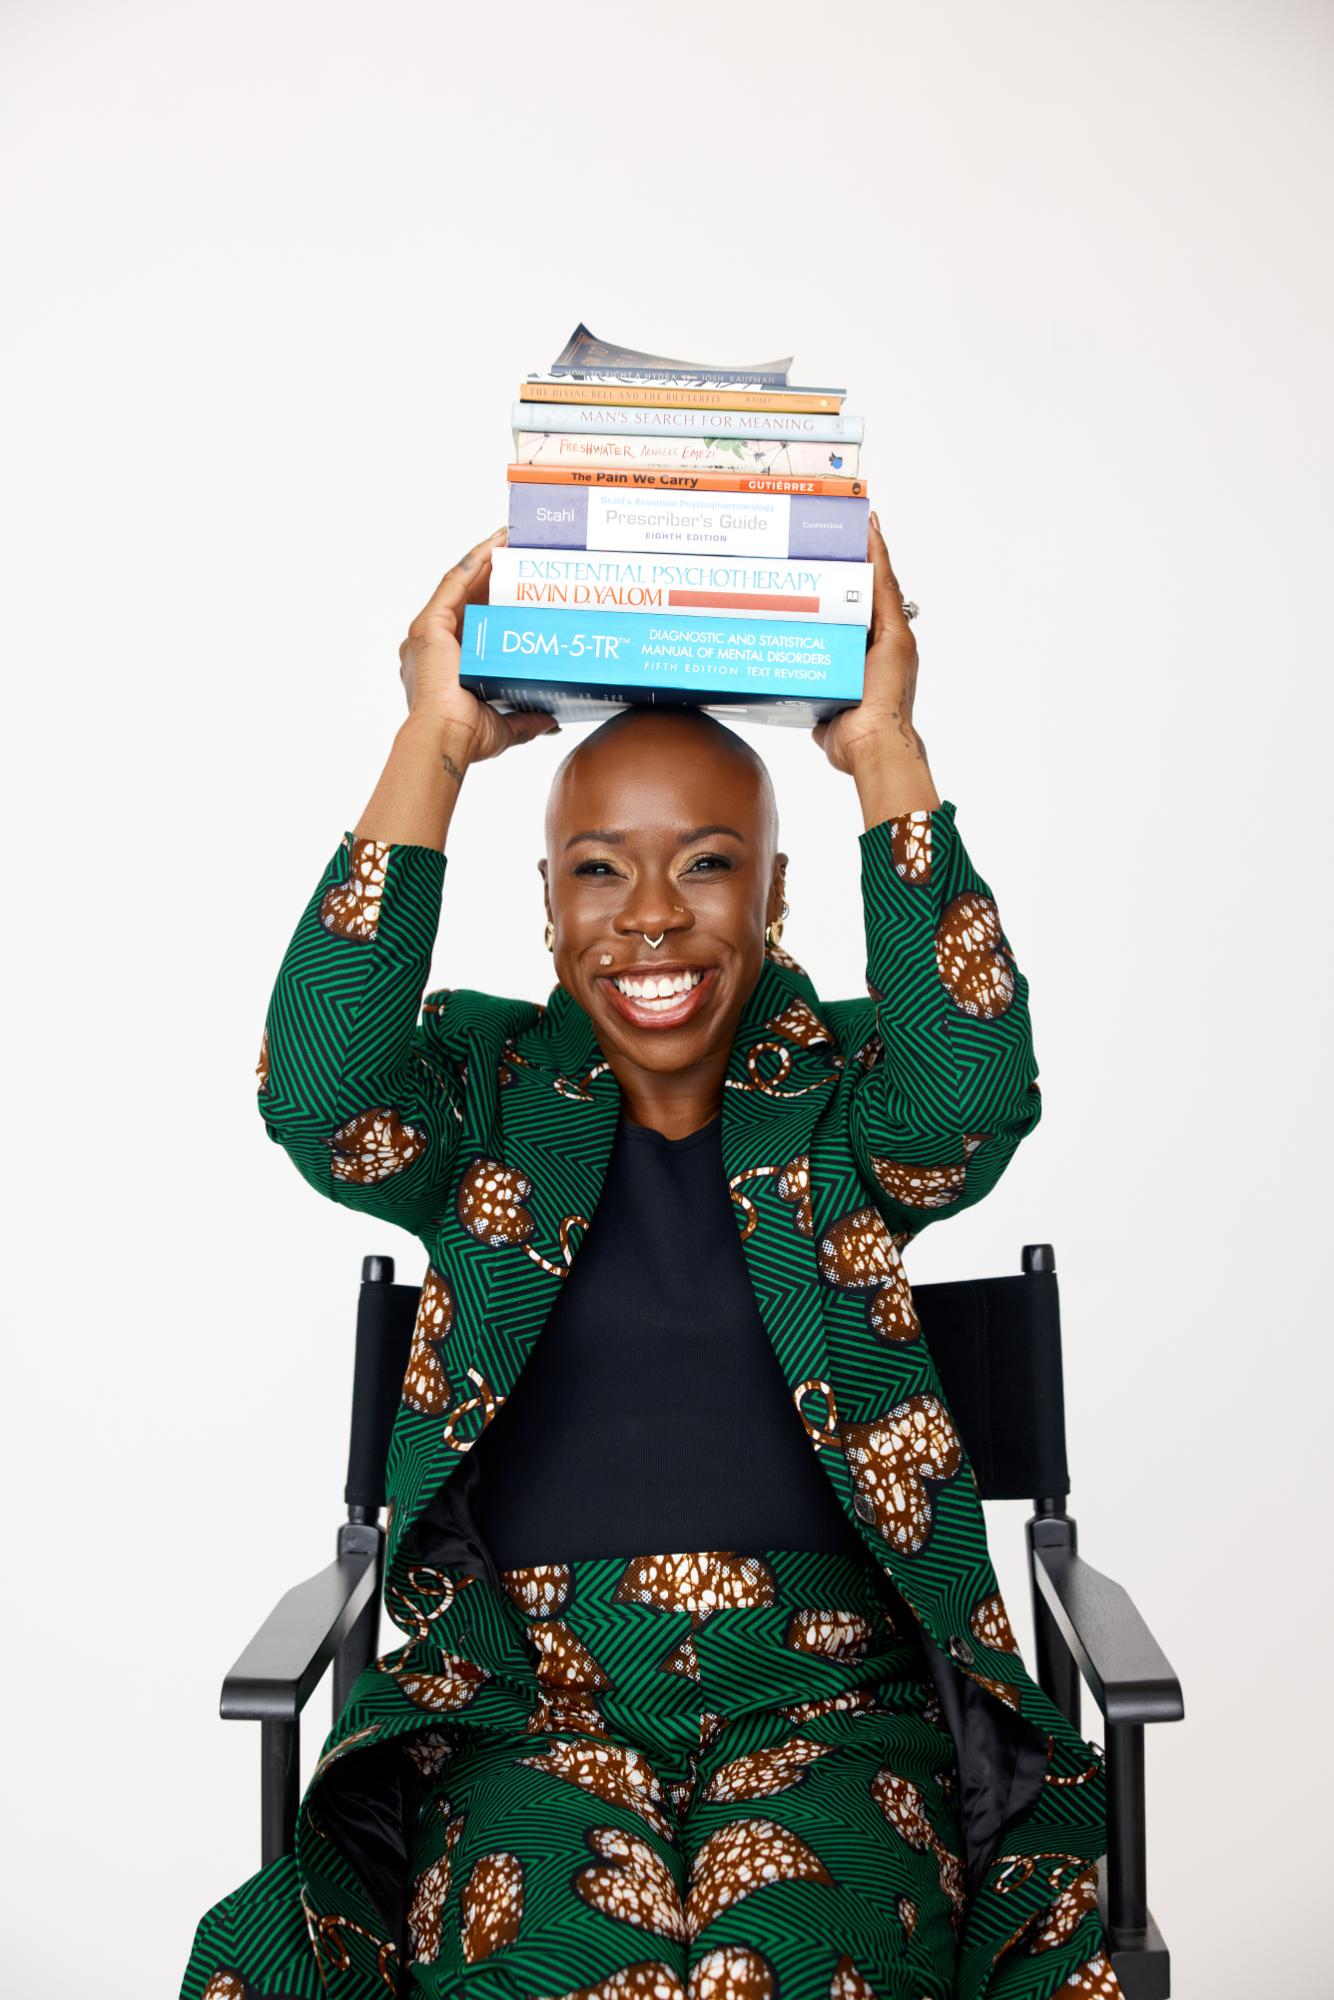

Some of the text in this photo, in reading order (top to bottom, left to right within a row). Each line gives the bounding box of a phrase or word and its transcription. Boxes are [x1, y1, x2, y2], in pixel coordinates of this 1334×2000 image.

[580, 410, 814, 432] MAN'S SEARCH FOR MEANING
[572, 472, 699, 488] The Pain We Carry
[748, 480, 814, 492] GUTIÉRREZ
[601, 496, 776, 513] Stahl's Essential Psychopharmacology
[536, 507, 575, 523] Stahl
[606, 509, 768, 531] Prescriber's Guide
[645, 531, 728, 543] EIGHTH EDITION
[518, 559, 822, 592] EXISTENTIAL PSYCHOTHERAPY
[516, 582, 568, 604] IRVIN
[650, 629, 826, 650] DIAGNOSTIC AND STATISTICAL
[641, 644, 832, 666] MANUAL OF MENTAL DISORDERS
[644, 661, 827, 681] FIFTH EDITION TEXT REVISION
